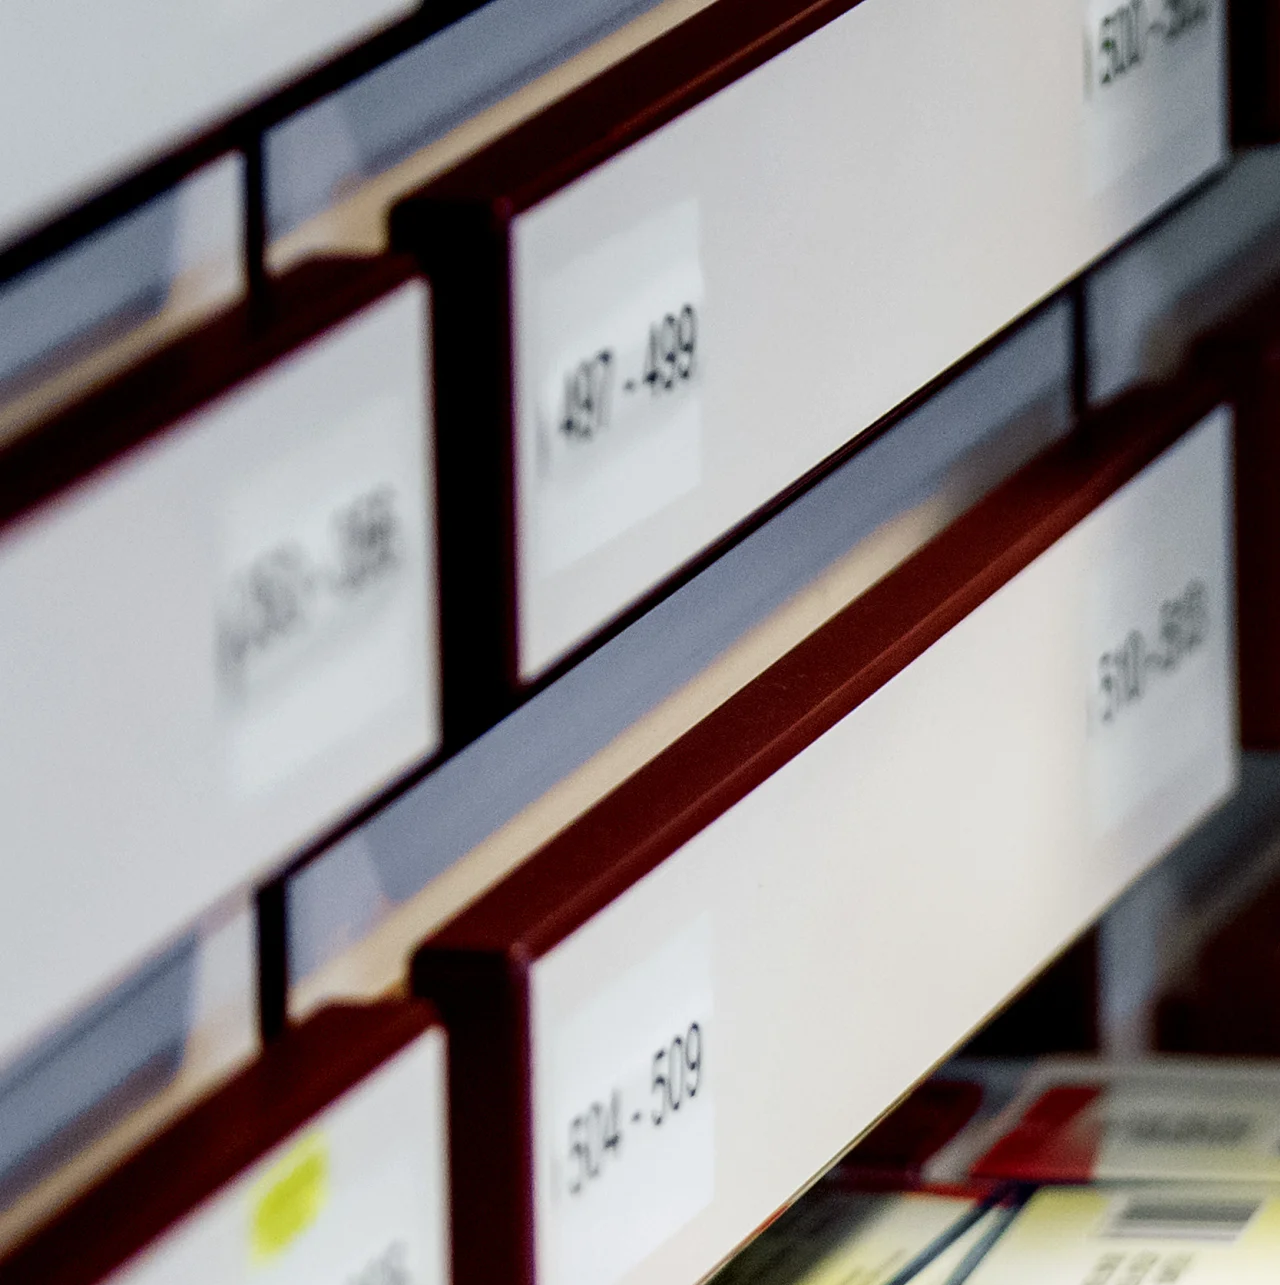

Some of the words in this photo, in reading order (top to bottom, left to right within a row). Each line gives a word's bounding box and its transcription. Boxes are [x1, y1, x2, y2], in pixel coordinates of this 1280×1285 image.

[643, 303, 698, 389] 499
[568, 1088, 622, 1197] 504
[651, 1021, 702, 1127] 509
